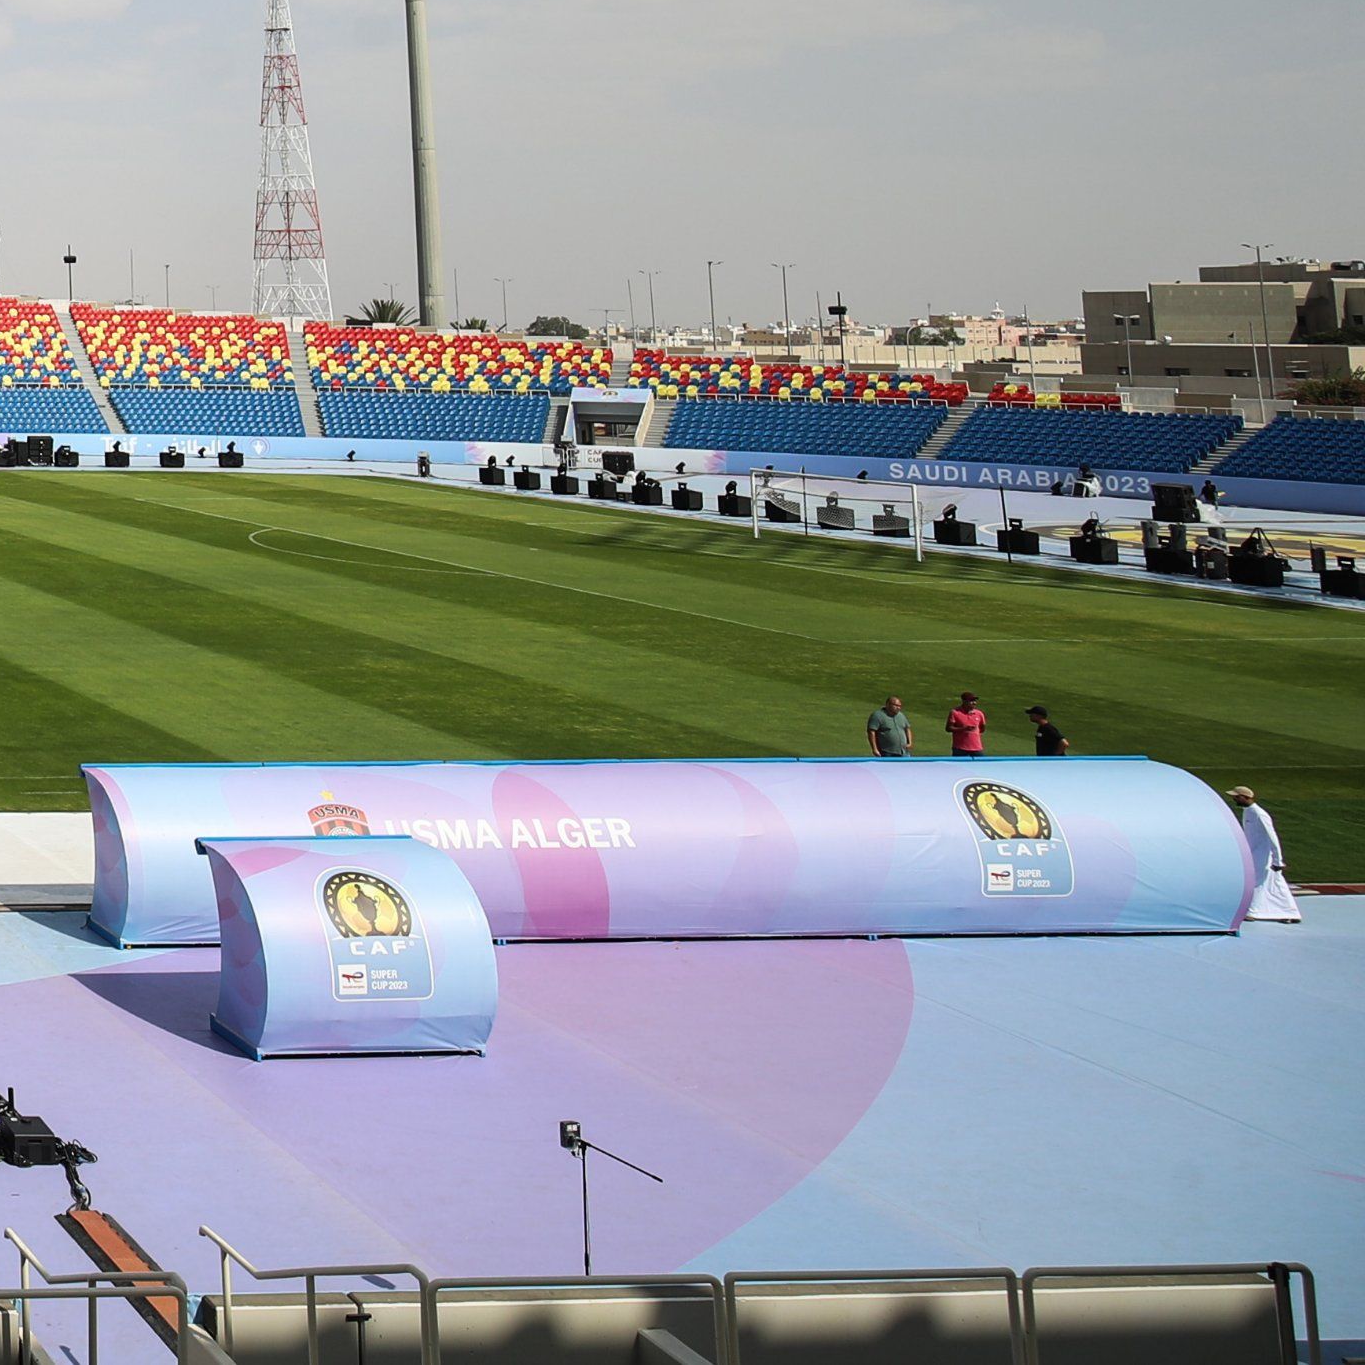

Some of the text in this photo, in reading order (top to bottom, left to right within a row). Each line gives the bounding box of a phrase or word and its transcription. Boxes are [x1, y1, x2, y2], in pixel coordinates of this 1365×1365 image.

[889, 462, 1150, 494] SAUDI ARABIA 023
[314, 806, 359, 819] USMA
[511, 817, 636, 849] ALGER
[996, 843, 1050, 856] CAF
[1016, 869, 1042, 878] SUPER
[1017, 879, 1032, 888] CUP
[350, 940, 407, 956] CAF
[370, 969, 398, 980] SUPER
[371, 980, 388, 990] CUP
[388, 981, 408, 990] 2023
